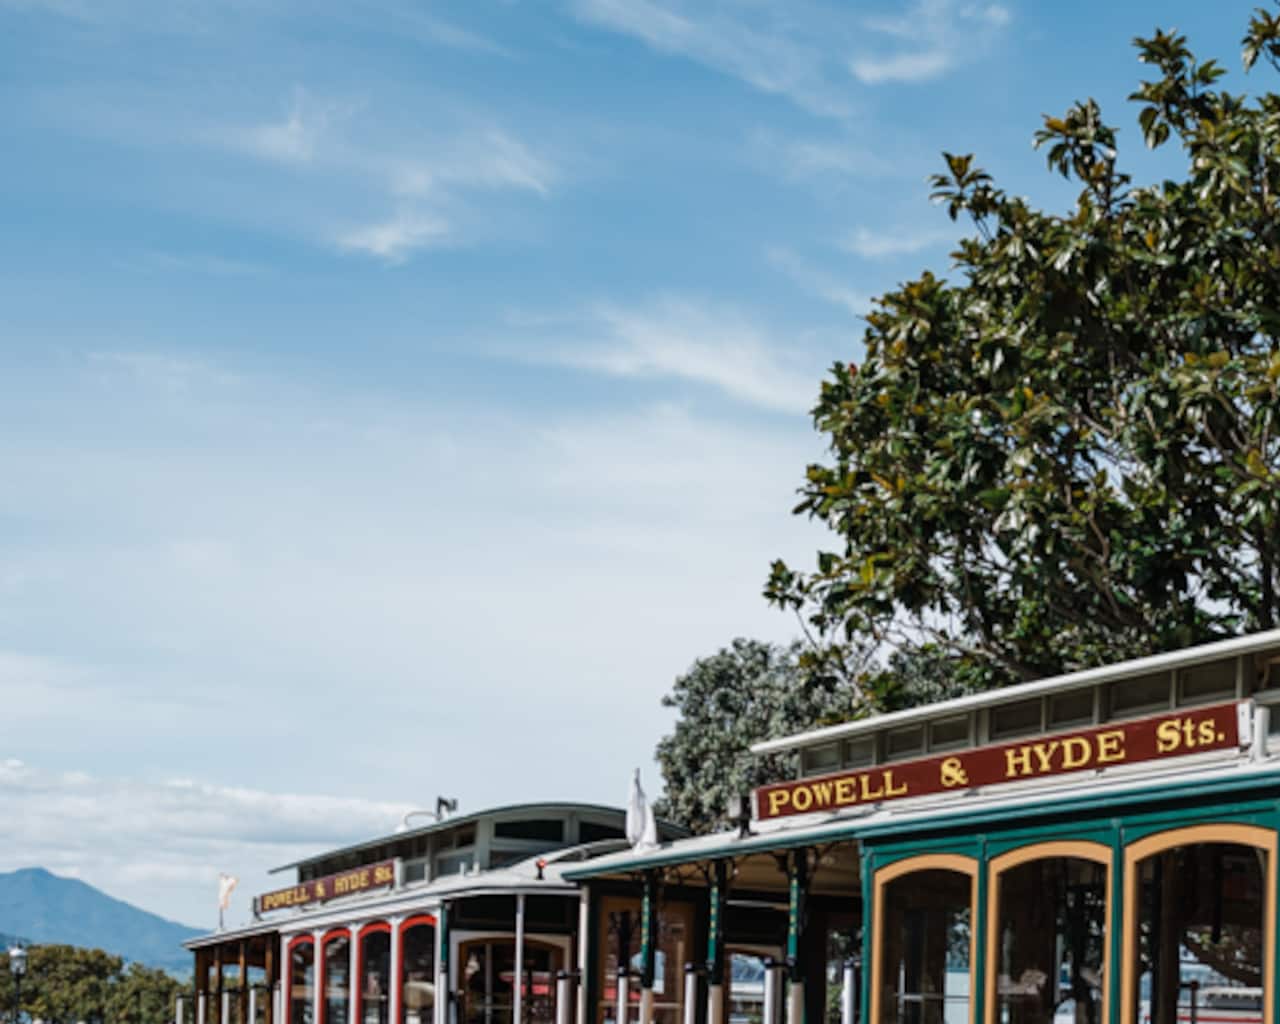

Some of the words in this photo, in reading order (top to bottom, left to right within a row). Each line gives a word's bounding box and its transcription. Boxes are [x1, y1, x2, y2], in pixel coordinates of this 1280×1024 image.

[768, 770, 907, 816] POWELL
[941, 758, 968, 787] &
[1005, 731, 1126, 778] HYDE
[1157, 718, 1226, 753] Sts.
[263, 887, 310, 910] POWELL
